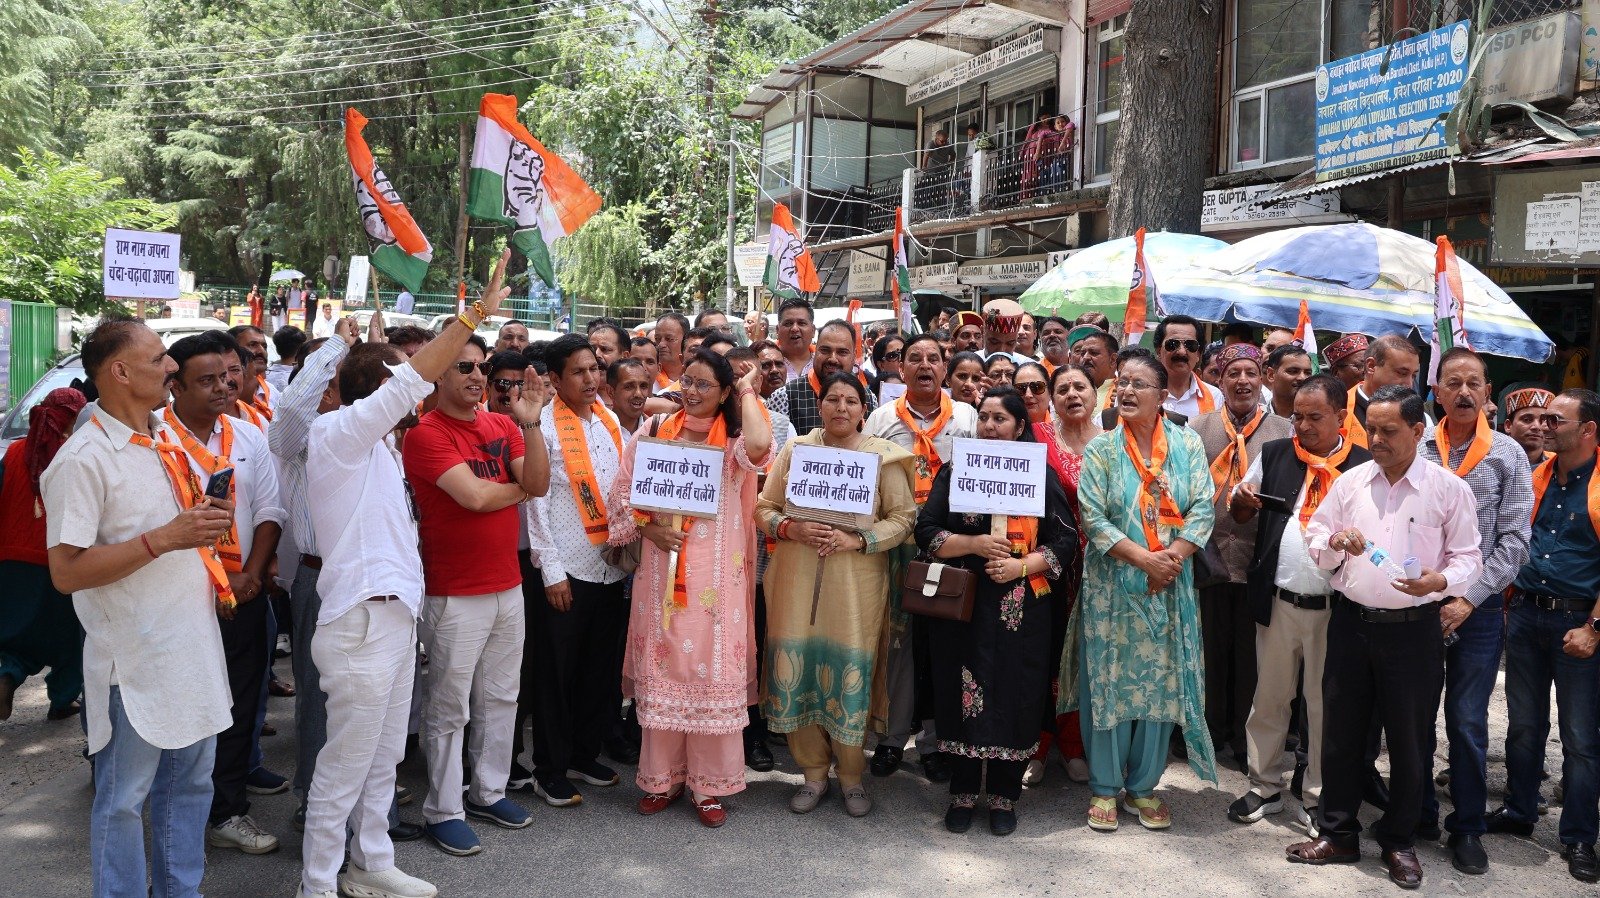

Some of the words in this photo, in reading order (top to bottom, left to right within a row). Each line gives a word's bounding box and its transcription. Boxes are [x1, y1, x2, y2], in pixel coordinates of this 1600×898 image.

[1520, 22, 1557, 45] PCO
[1337, 96, 1359, 115] नवोदय
[1393, 81, 1411, 101] प्रवेश
[1398, 97, 1428, 116] SELECTION
[1218, 191, 1248, 206] GUPTA
[1324, 202, 1331, 213] 2
[115, 240, 130, 256] राम
[131, 241, 147, 257] नाम
[147, 243, 171, 259] जपना
[108, 259, 152, 287] चंदा-चढ़ावा
[152, 269, 175, 285] अपना
[864, 262, 881, 273] RANA
[1001, 261, 1040, 275] MARWAH
[646, 457, 678, 475] जनता
[678, 457, 691, 476] के
[691, 459, 711, 479] चोर
[801, 460, 833, 477] जनता
[833, 459, 846, 477] के
[846, 461, 866, 480] चोर
[966, 452, 983, 468] राम
[983, 454, 1003, 470] नाम
[1002, 456, 1031, 473] जपना
[635, 476, 654, 495] नहीं
[653, 478, 676, 498] चलेंगे
[675, 481, 694, 500] नहीं
[693, 483, 717, 503] चलेंगे
[790, 478, 809, 497] नहीं
[808, 480, 830, 499] चलेंगे
[830, 482, 849, 501] नहीं
[848, 484, 871, 504] चलेंगे
[957, 471, 1008, 498] चंदा-चढ़ावा
[1008, 482, 1037, 499] अपना
